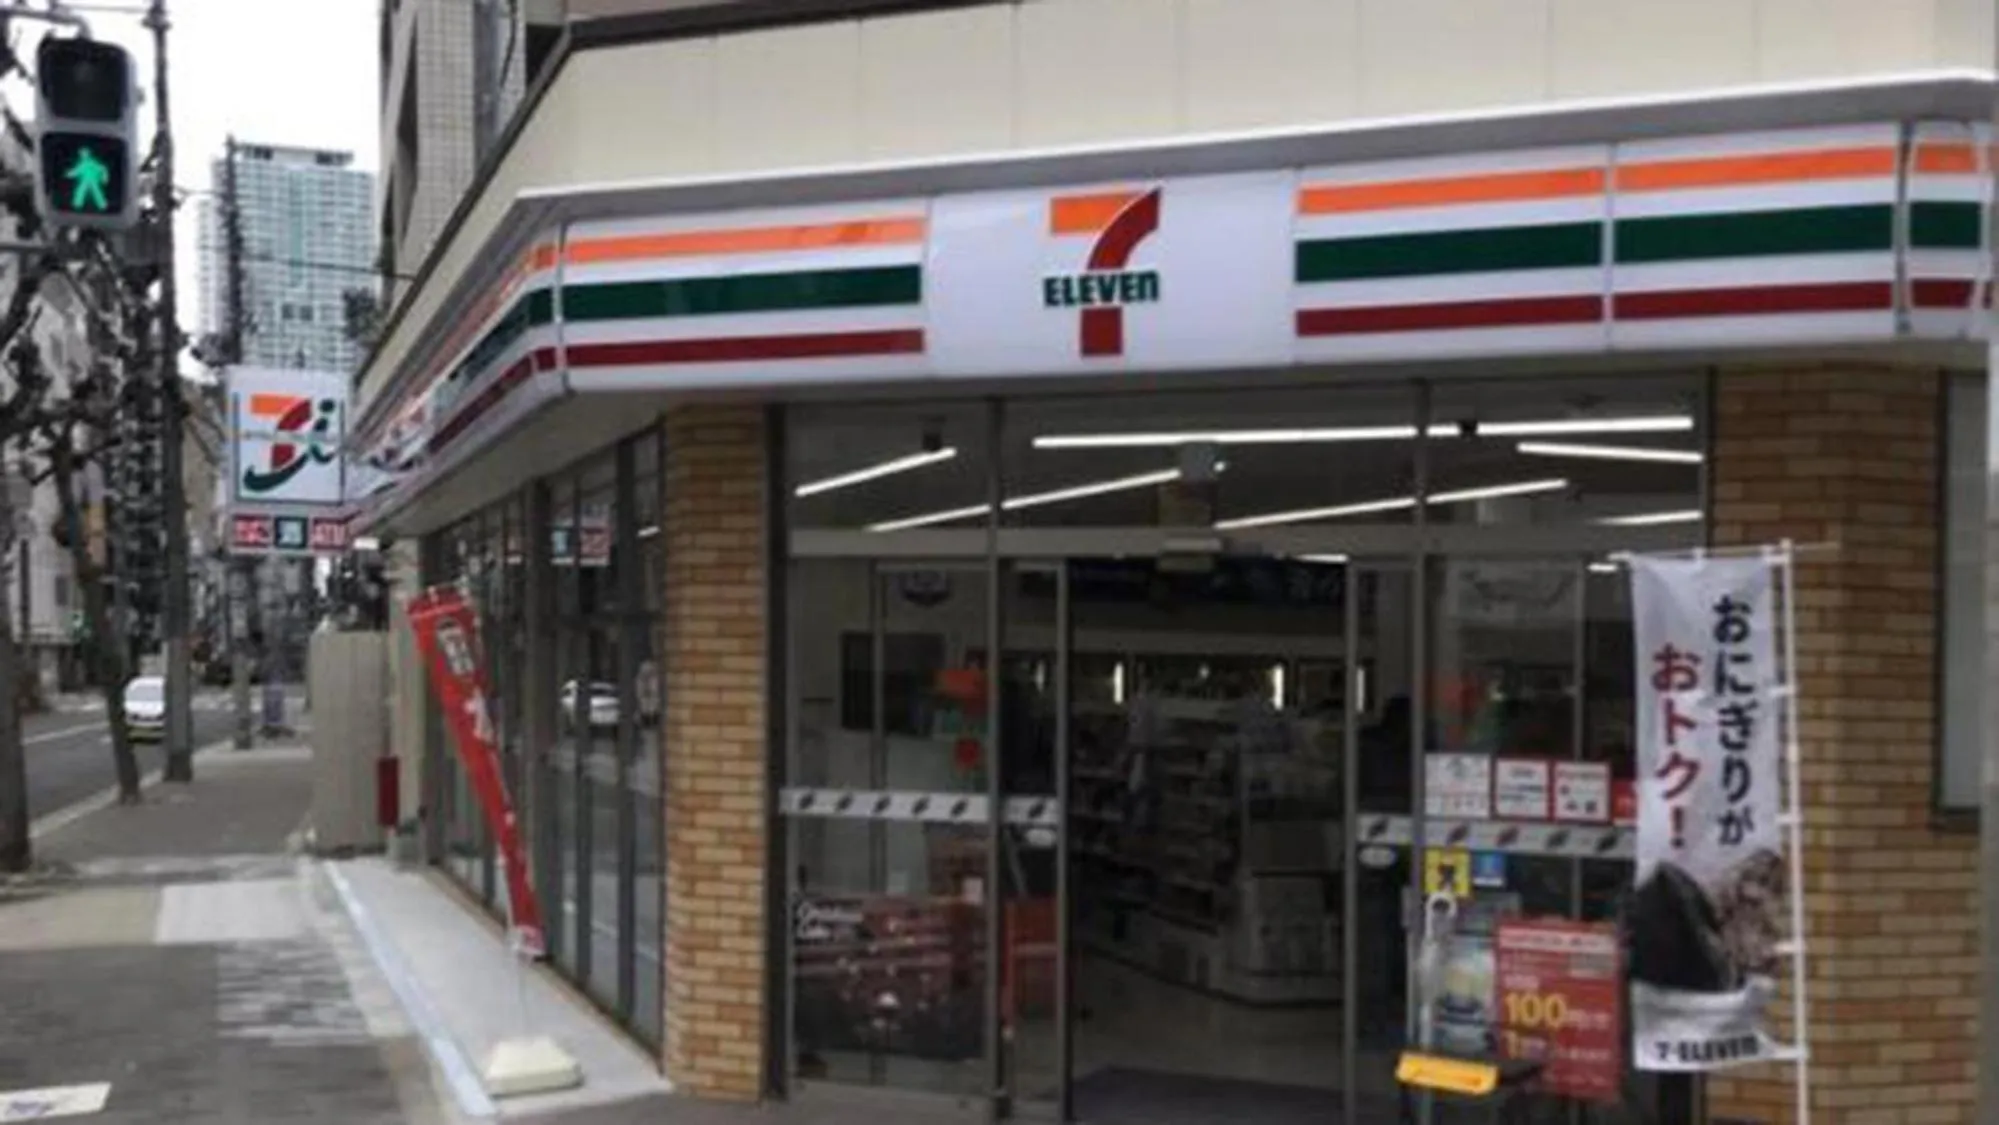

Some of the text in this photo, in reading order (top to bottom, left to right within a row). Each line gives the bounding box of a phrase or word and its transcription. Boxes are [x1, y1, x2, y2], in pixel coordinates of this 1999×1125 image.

[1051, 186, 1162, 356] 7
[1652, 642, 1702, 849] おトク！
[1712, 593, 1758, 846] おにぎりが
[1504, 992, 1567, 1029] 100
